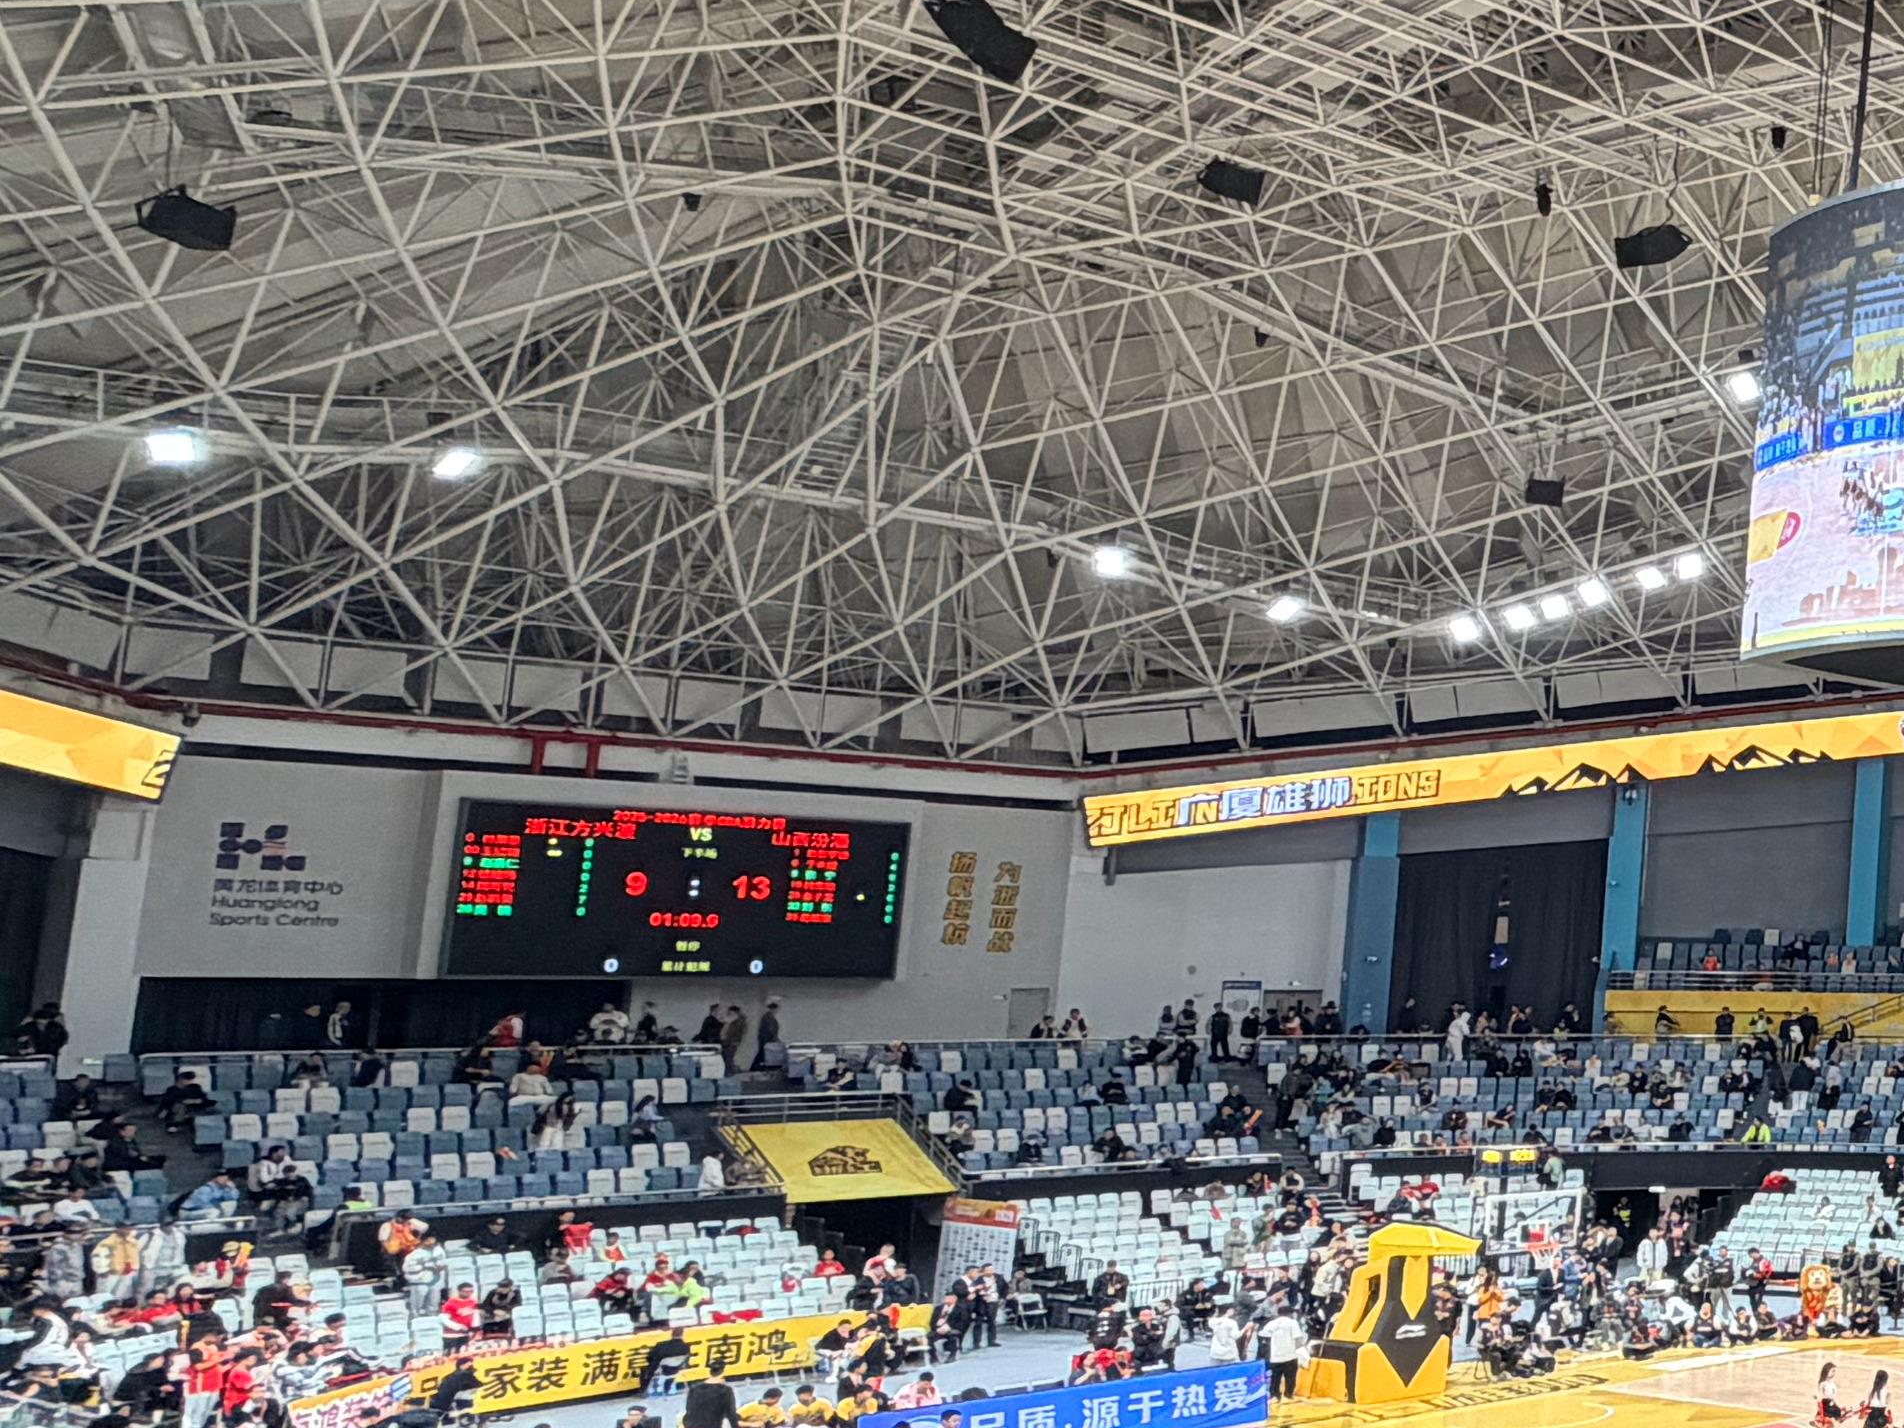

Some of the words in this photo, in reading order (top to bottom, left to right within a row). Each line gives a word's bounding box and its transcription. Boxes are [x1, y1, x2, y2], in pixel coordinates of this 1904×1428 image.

[1178, 776, 1352, 826] 广厦雄狮
[690, 827, 713, 841] VS
[213, 878, 344, 896] 黄龙体育中心
[625, 872, 648, 897] 9
[732, 875, 772, 901] 13
[211, 895, 320, 913] Huanglong
[208, 912, 271, 926] Sports
[275, 913, 340, 928] Centre
